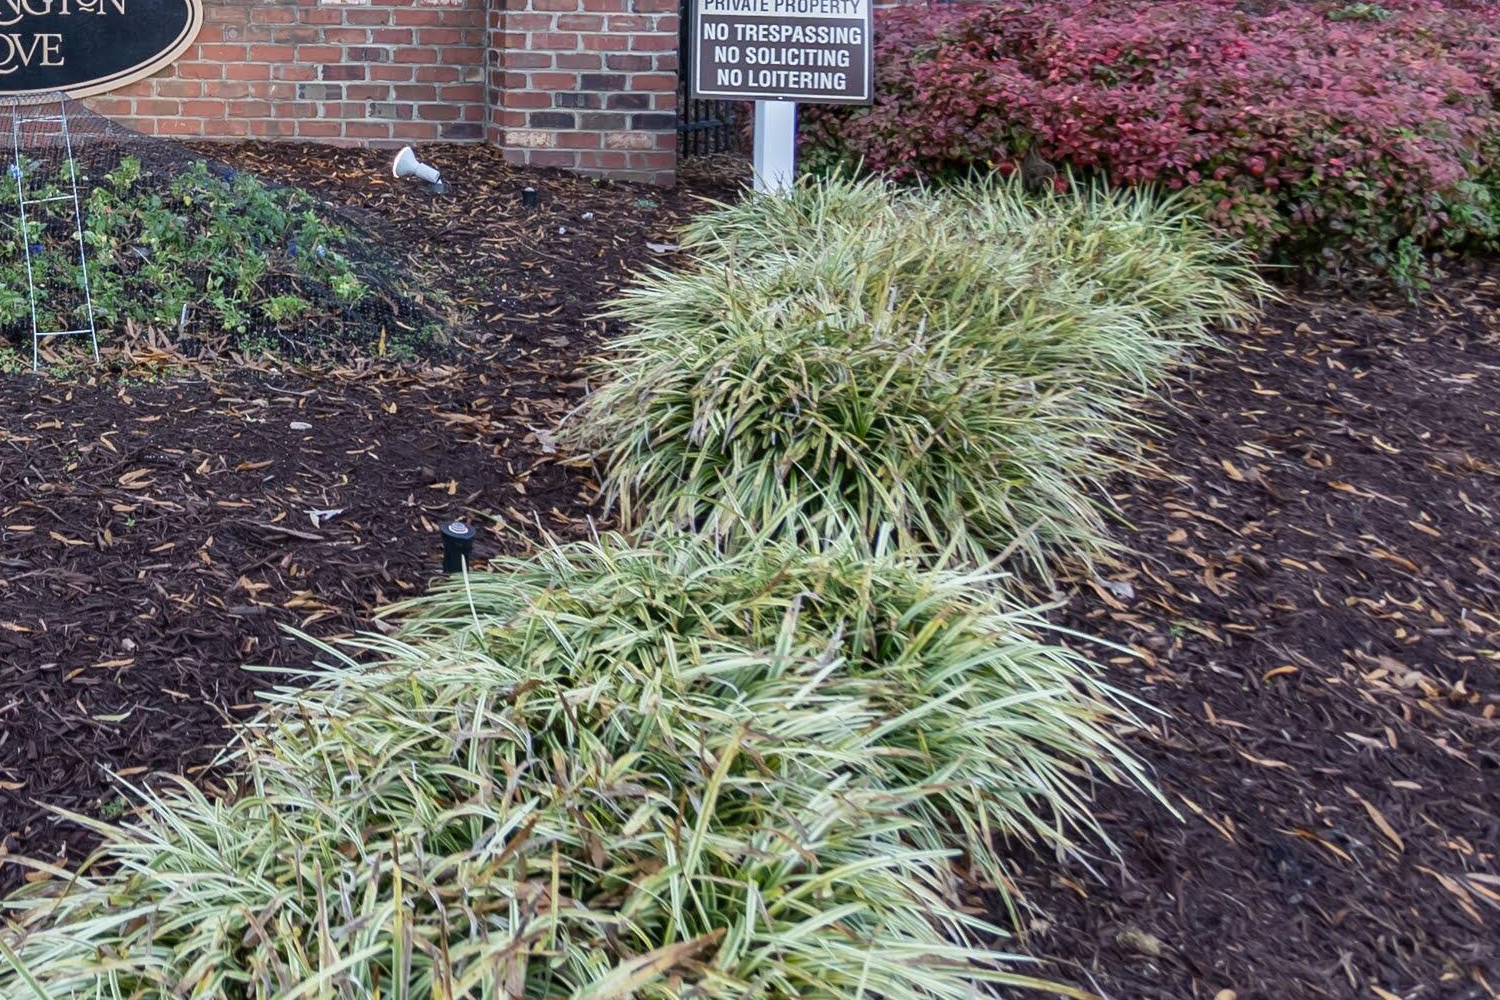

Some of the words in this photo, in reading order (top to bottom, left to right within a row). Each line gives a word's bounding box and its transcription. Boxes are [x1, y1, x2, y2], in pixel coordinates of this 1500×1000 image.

[703, 22, 729, 41] NO
[734, 23, 862, 45] TRESPASSING
[714, 45, 740, 64] NO
[745, 47, 850, 68] SOLICITING
[717, 68, 743, 86] NO
[748, 70, 846, 90] LOITERING
